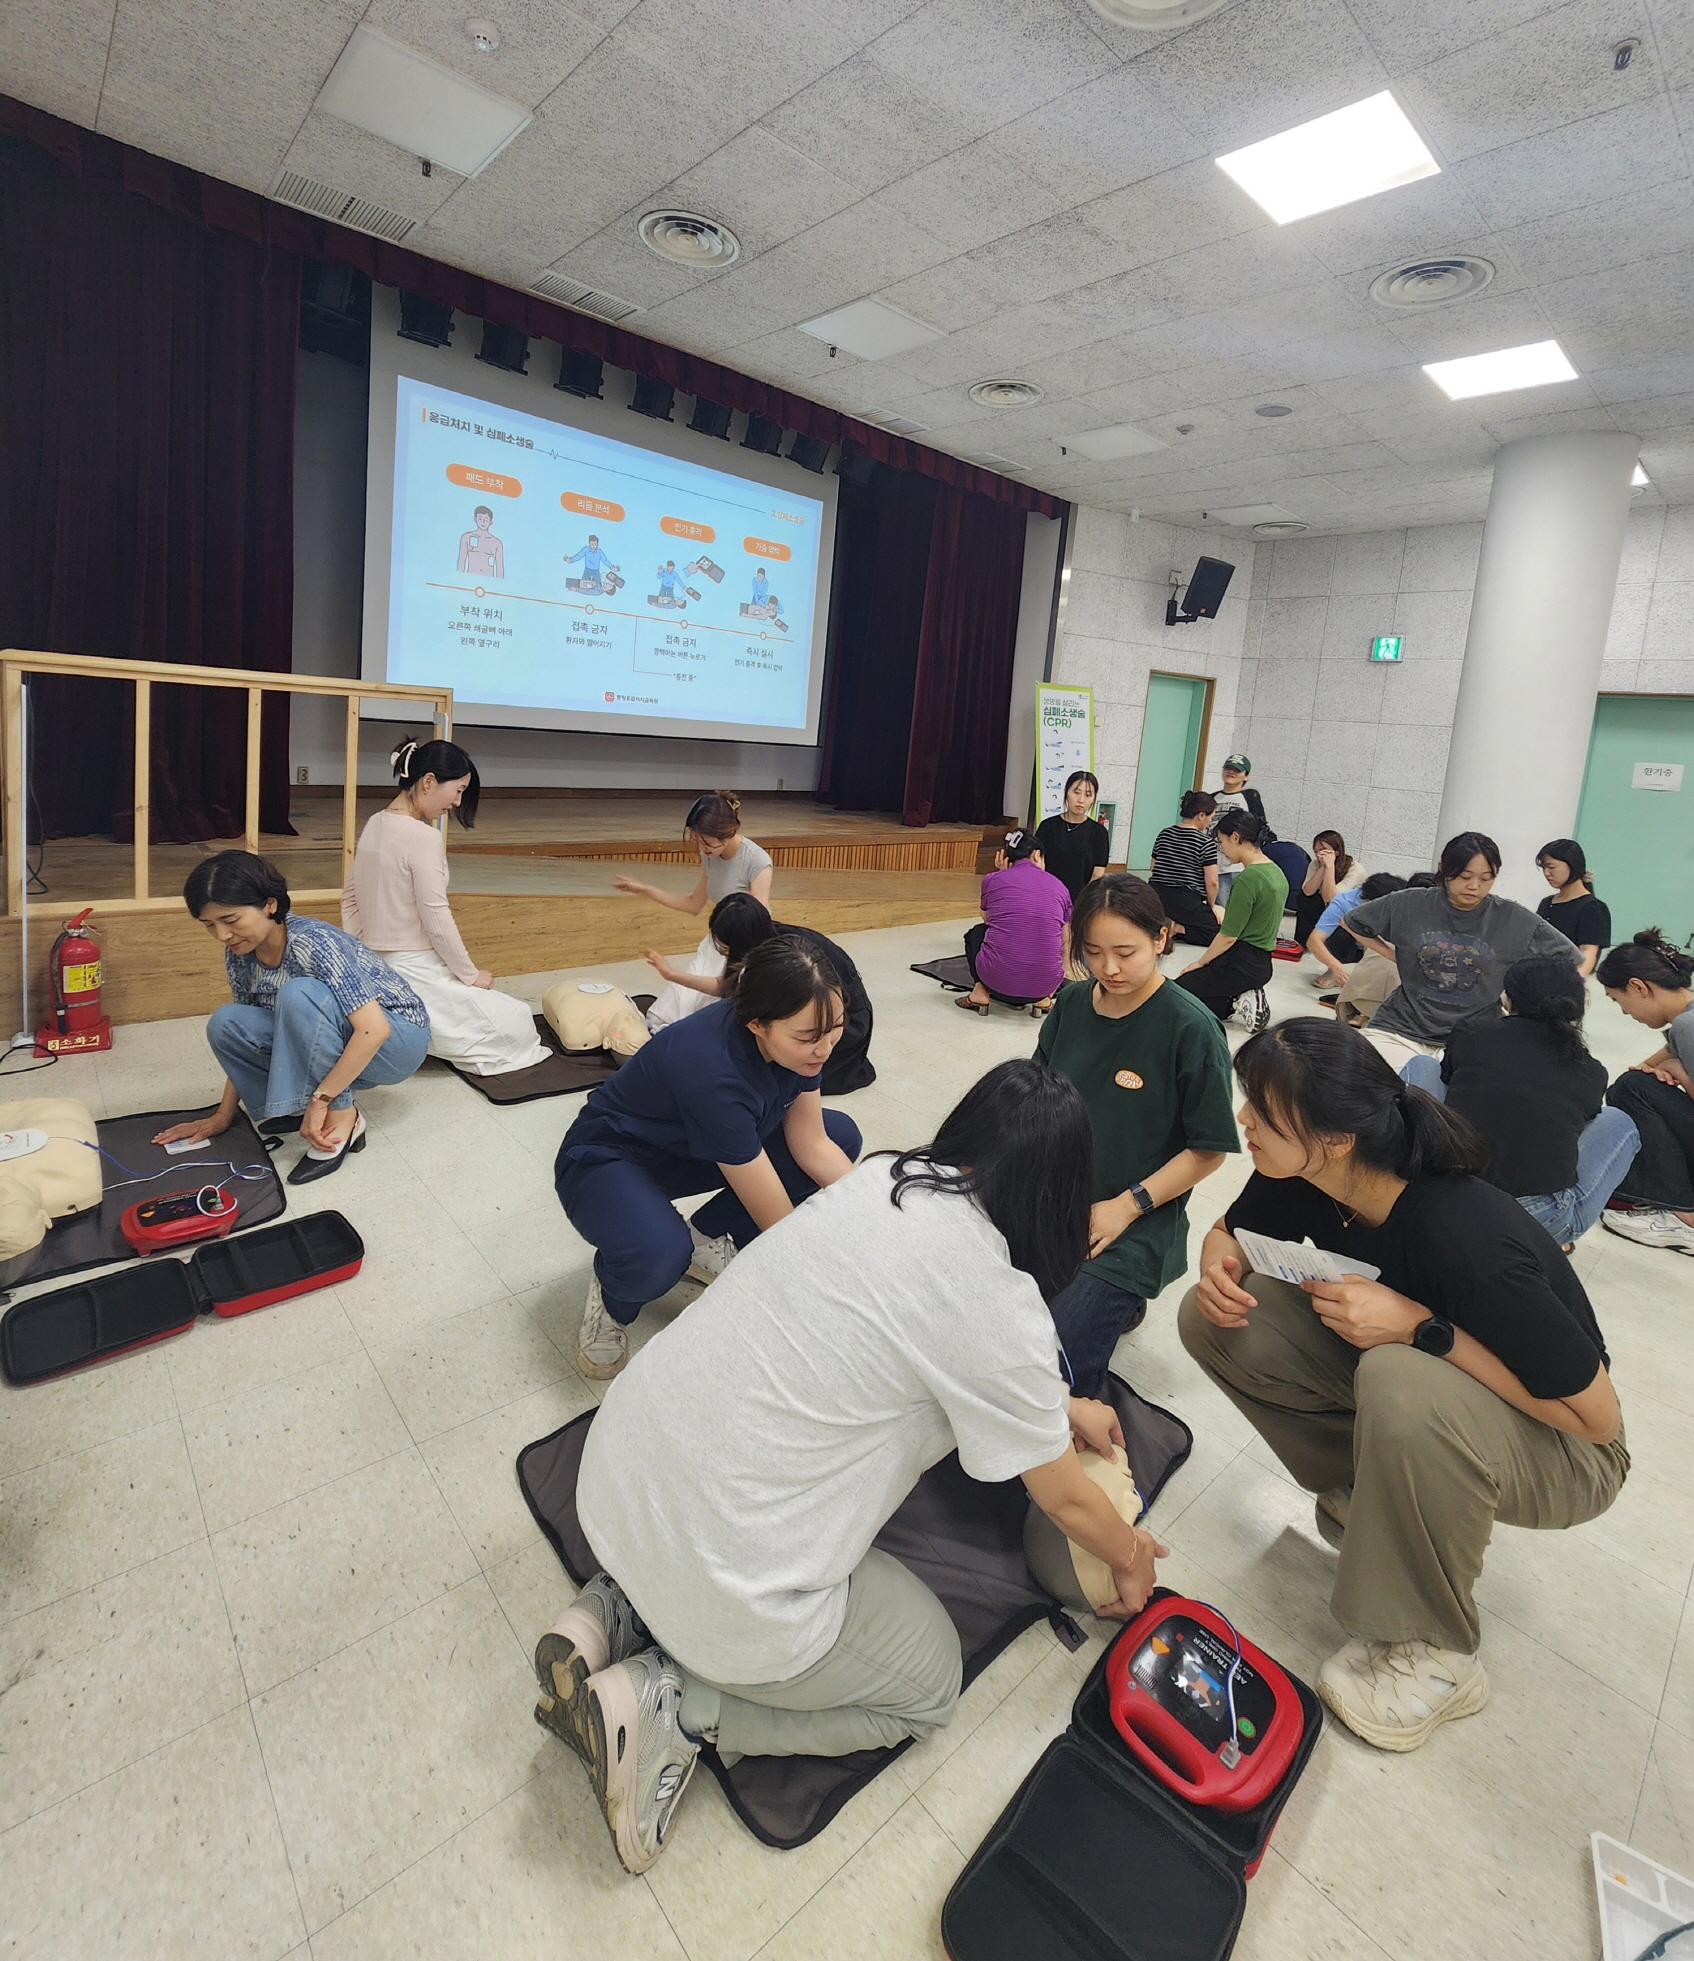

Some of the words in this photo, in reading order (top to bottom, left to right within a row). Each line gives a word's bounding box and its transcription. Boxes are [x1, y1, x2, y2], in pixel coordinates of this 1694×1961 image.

[428, 411, 471, 433] 응급처치
[473, 423, 484, 437] 및
[486, 427, 534, 450] 심폐소생술
[465, 472, 484, 486] 패드
[486, 477, 504, 491] 부착
[577, 499, 593, 512] 리듬
[594, 503, 610, 515] 분석
[674, 523, 688, 535] 전기
[689, 526, 703, 537] 충격
[755, 542, 768, 553] 가슴
[768, 545, 781, 556] 압박
[460, 604, 481, 618] 부착
[483, 608, 503, 621] 위치
[447, 620, 472, 633] 오른쪽
[473, 624, 497, 636] 쇄골뼈
[498, 627, 513, 637] 아래
[571, 620, 589, 633] 접촉
[591, 623, 608, 636] 금지
[460, 636, 476, 648] 왼쪽
[477, 638, 500, 649] 옆구리
[565, 636, 586, 646] 환자와
[586, 639, 612, 650] 떨어지기
[665, 634, 681, 645] 접촉
[682, 637, 697, 648] 금지
[677, 651, 689, 660] 버튼
[690, 652, 706, 662] 누르기
[746, 646, 759, 657] 즉시
[761, 648, 774, 660] 실시
[1062, 699, 1080, 708] 살리는
[1043, 707, 1085, 718] 심폐소생술
[1043, 717, 1072, 728] (CPR)
[1644, 768, 1673, 777] 환기중
[61, 1035, 100, 1045] 소화기
[1193, 1636, 1228, 1670] TRAINER
